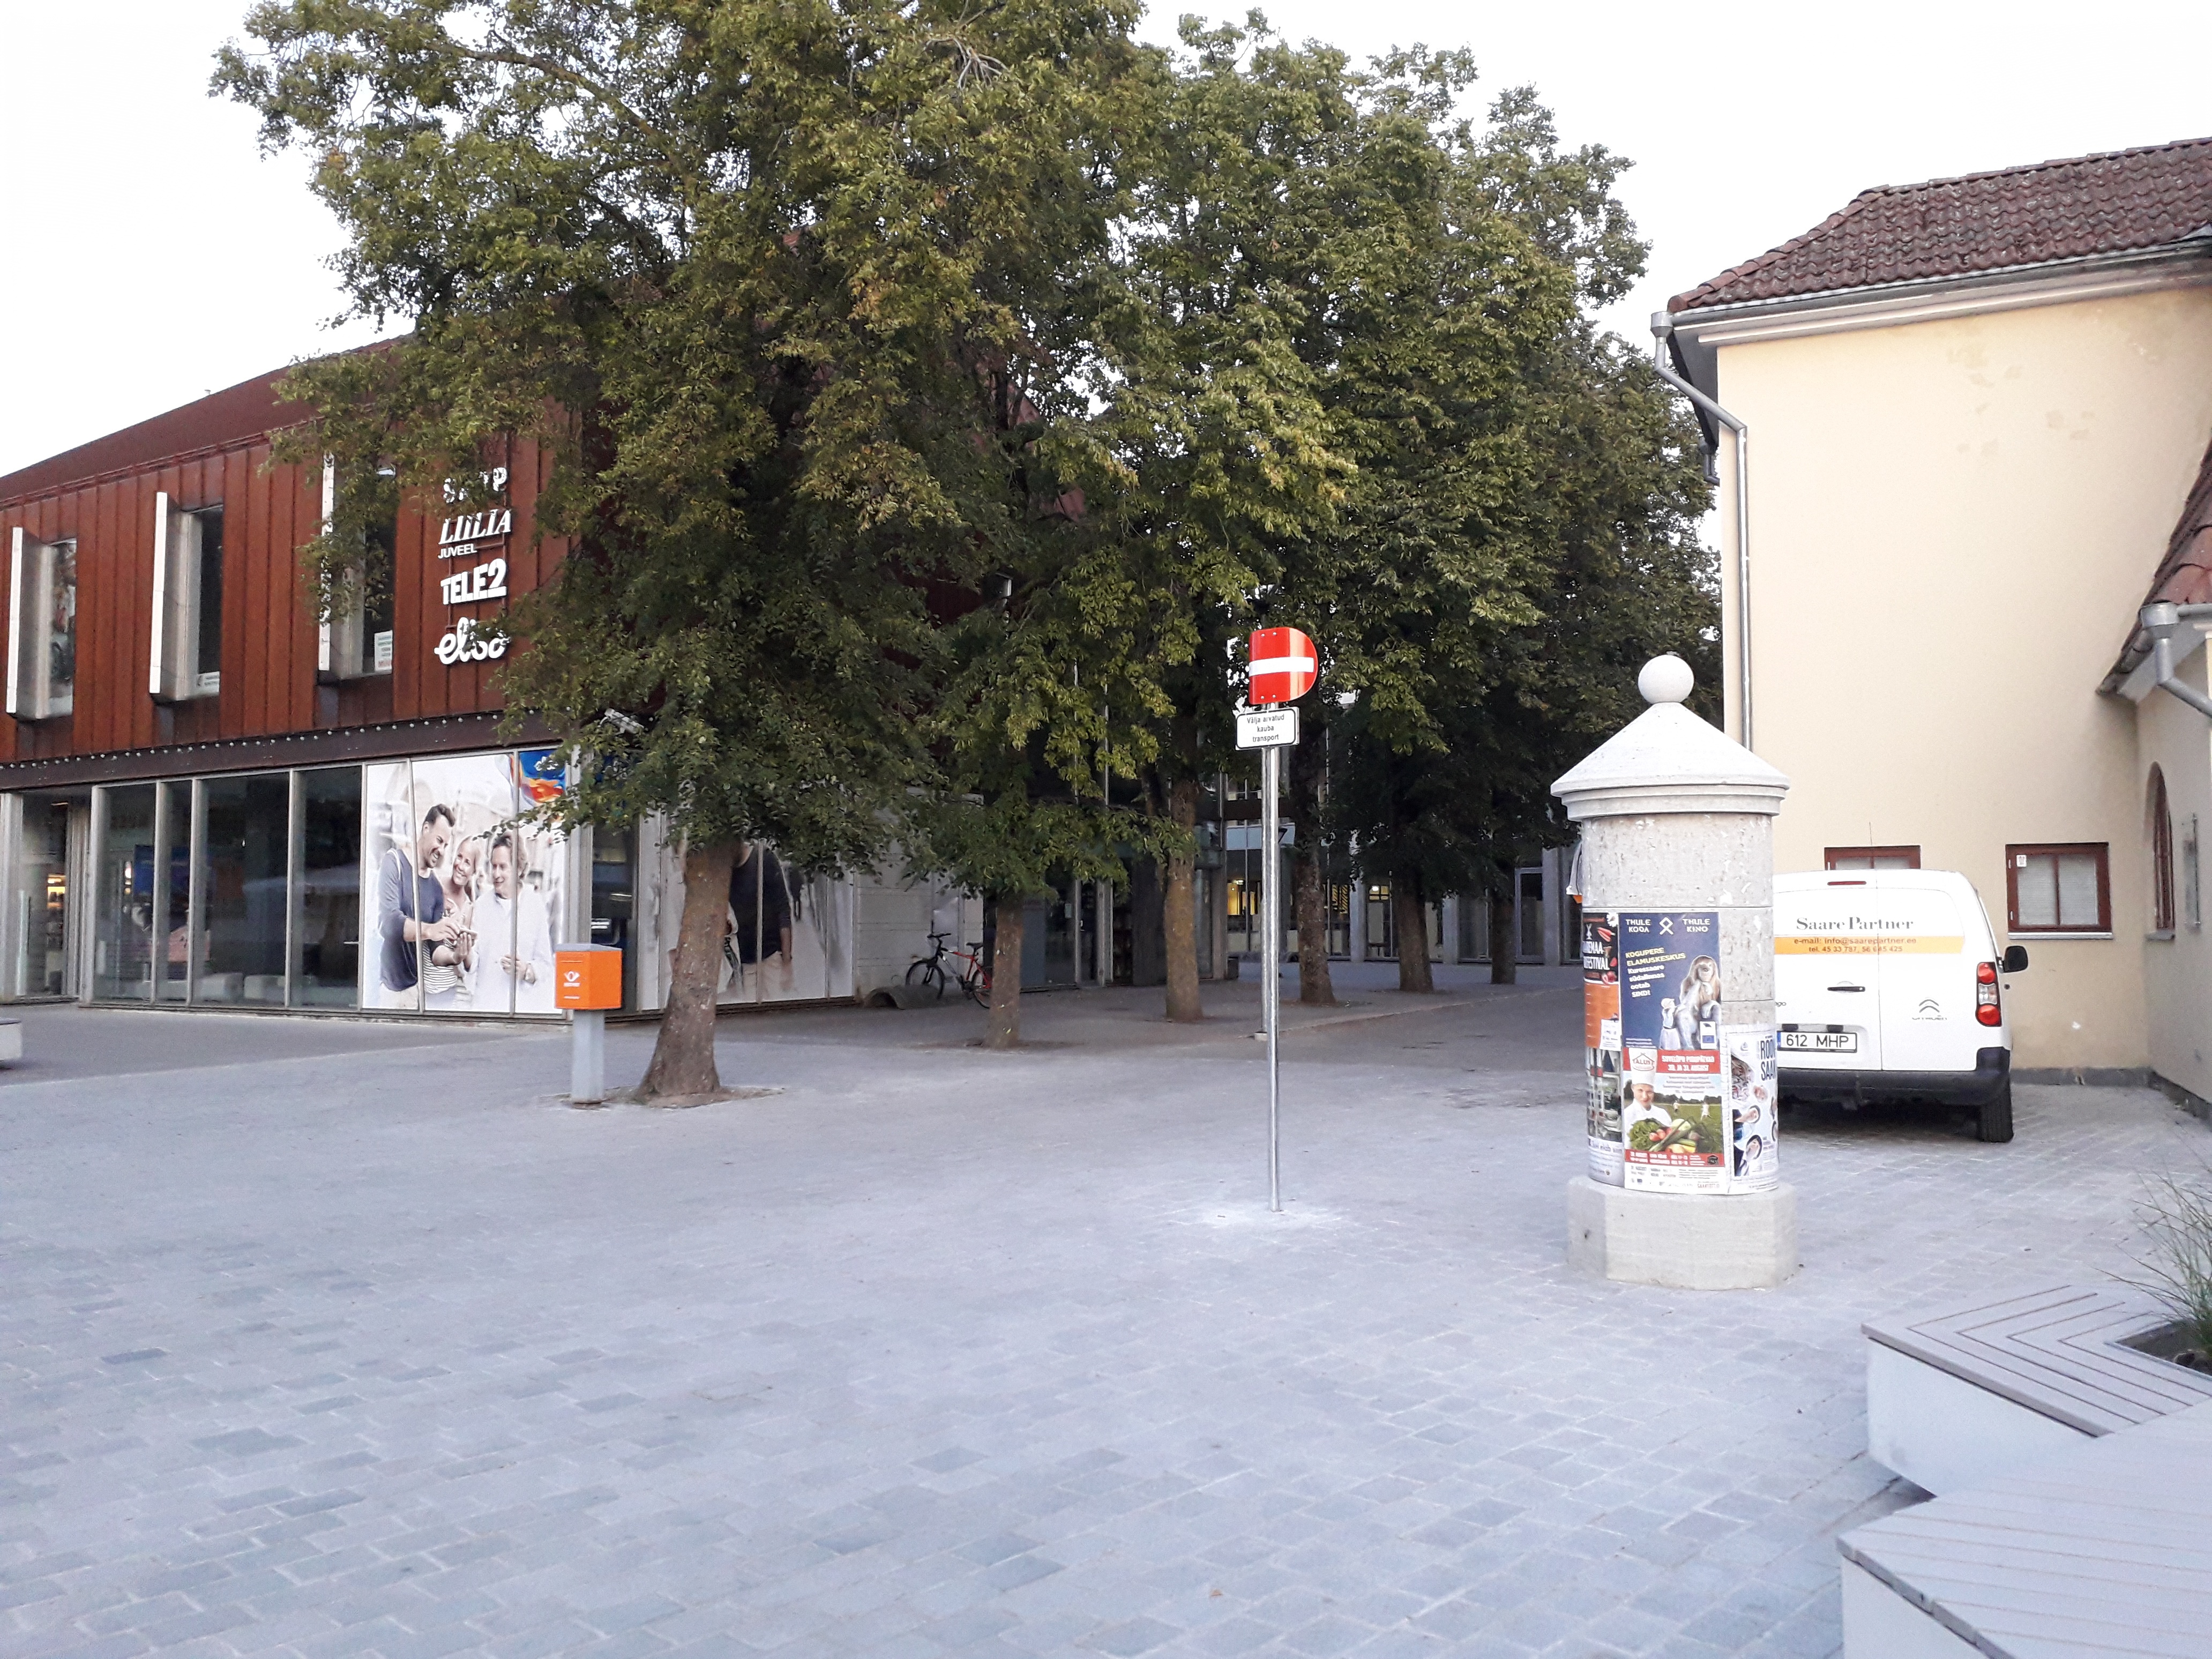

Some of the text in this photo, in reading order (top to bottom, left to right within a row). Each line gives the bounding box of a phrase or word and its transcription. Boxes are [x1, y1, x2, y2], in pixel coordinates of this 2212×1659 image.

[438, 543, 477, 559] JUVEEL
[440, 558, 507, 605] TELE2
[1247, 714, 1284, 724] Välja arvatud
[1252, 734, 1279, 742] transport
[1796, 917, 1914, 930] Saare Partner
[1625, 947, 1664, 958] KOGUPERE
[1627, 953, 1686, 966] ELAMUSKESKUS
[1787, 1034, 1849, 1048] 612 MHP
